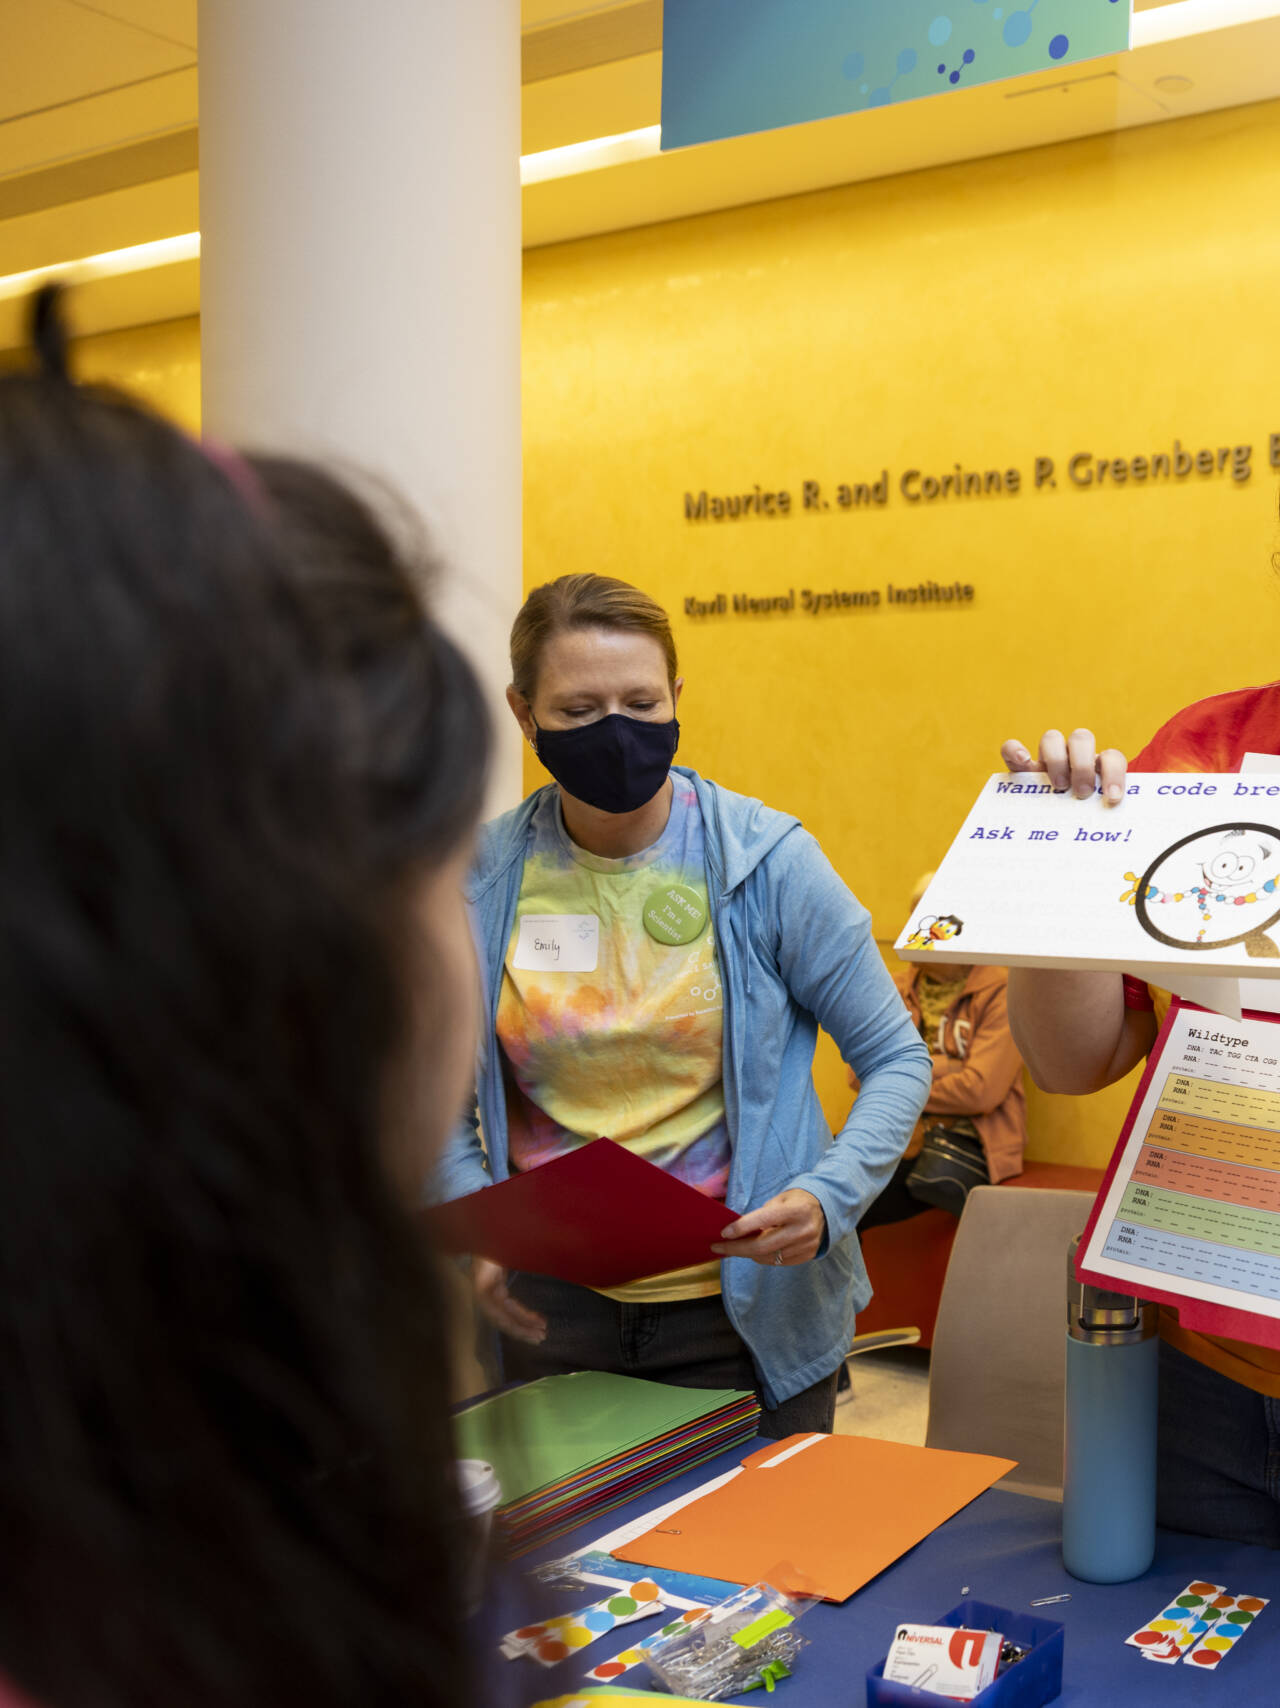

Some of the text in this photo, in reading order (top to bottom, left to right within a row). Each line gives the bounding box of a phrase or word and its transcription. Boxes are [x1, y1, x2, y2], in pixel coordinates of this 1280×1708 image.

[684, 484, 791, 520] Maurice
[802, 480, 829, 510] R.
[837, 469, 889, 507] and
[900, 463, 1020, 501] Corinne
[1035, 456, 1057, 488] P.
[1068, 439, 1252, 486] Greenberg
[733, 589, 795, 613] Neural
[801, 589, 881, 615] Systems
[888, 581, 975, 604] Institute
[1126, 785, 1140, 795] a
[1157, 782, 1217, 796] code
[969, 826, 1132, 842] Ask me how!
[666, 889, 687, 905] ASK
[534, 936, 560, 961] Emily
[1187, 1028, 1249, 1047] Wildtype
